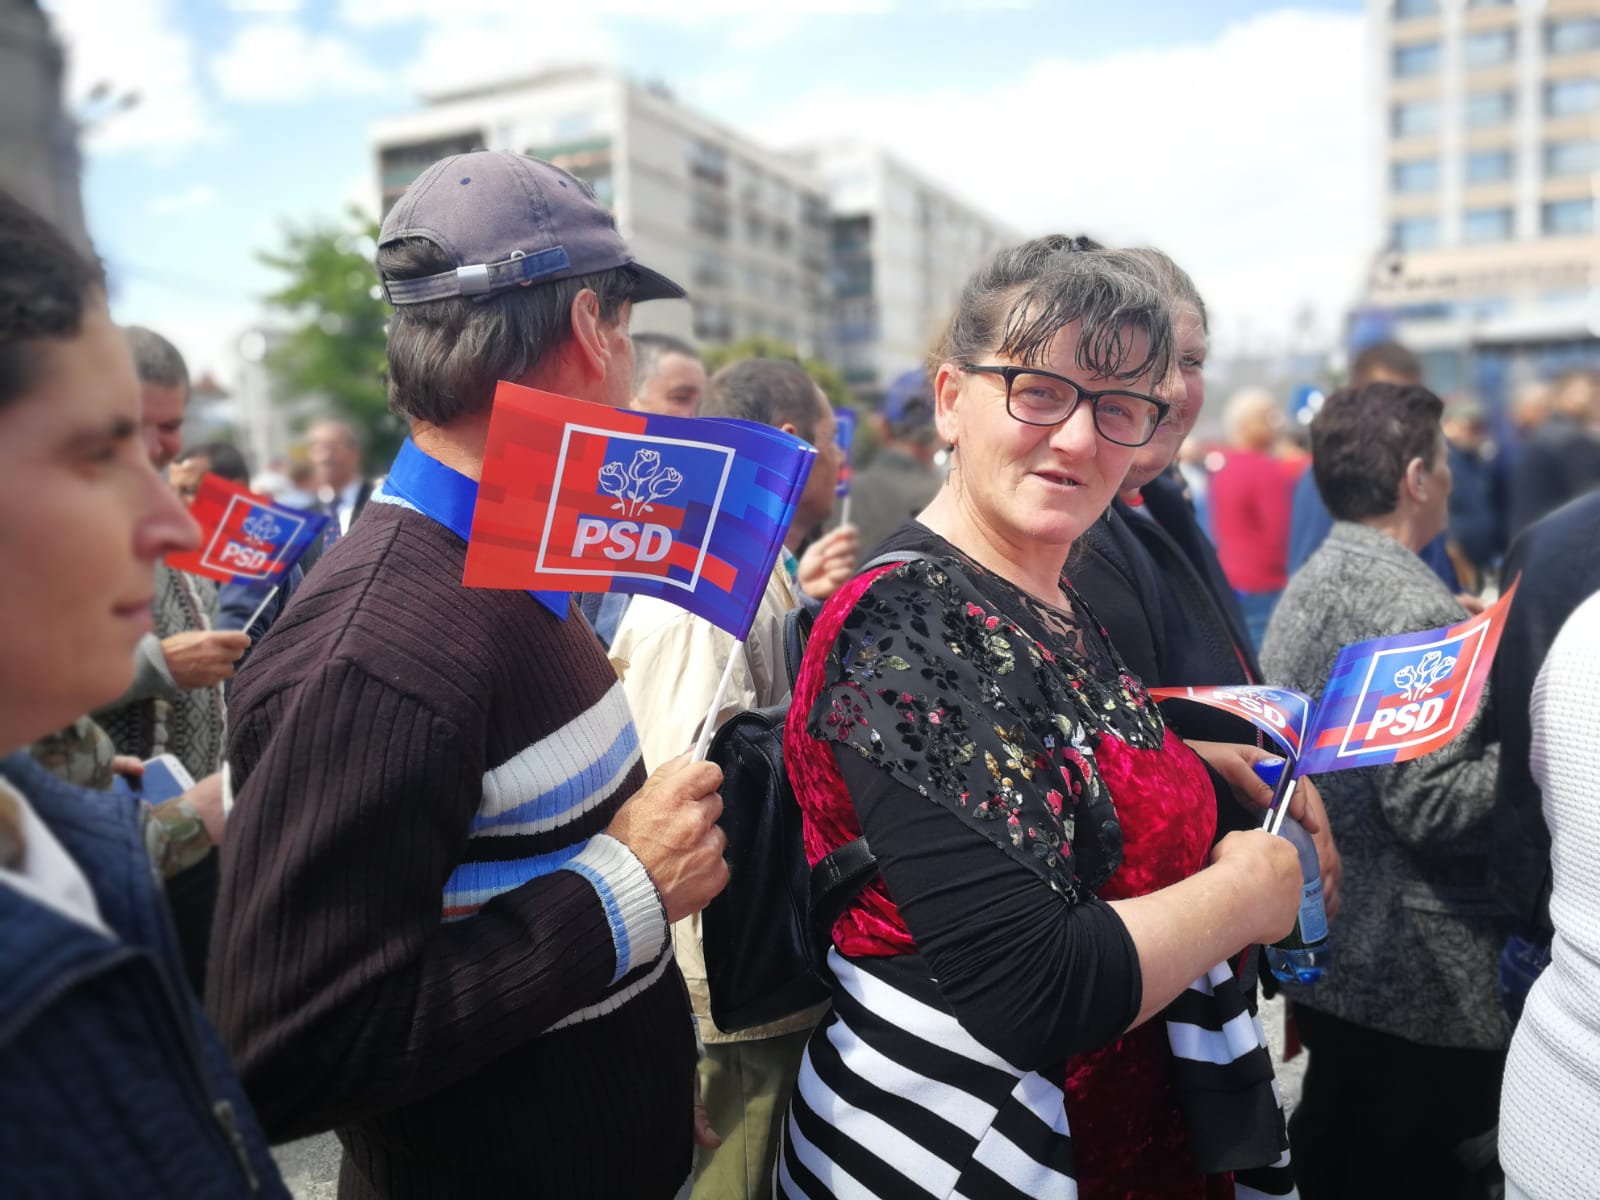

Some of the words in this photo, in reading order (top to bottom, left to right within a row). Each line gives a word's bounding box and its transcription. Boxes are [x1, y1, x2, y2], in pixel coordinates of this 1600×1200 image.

[221, 542, 268, 568] PSD
[571, 518, 672, 561] PSD
[1213, 690, 1286, 728] PSD
[1366, 698, 1443, 739] PSD
